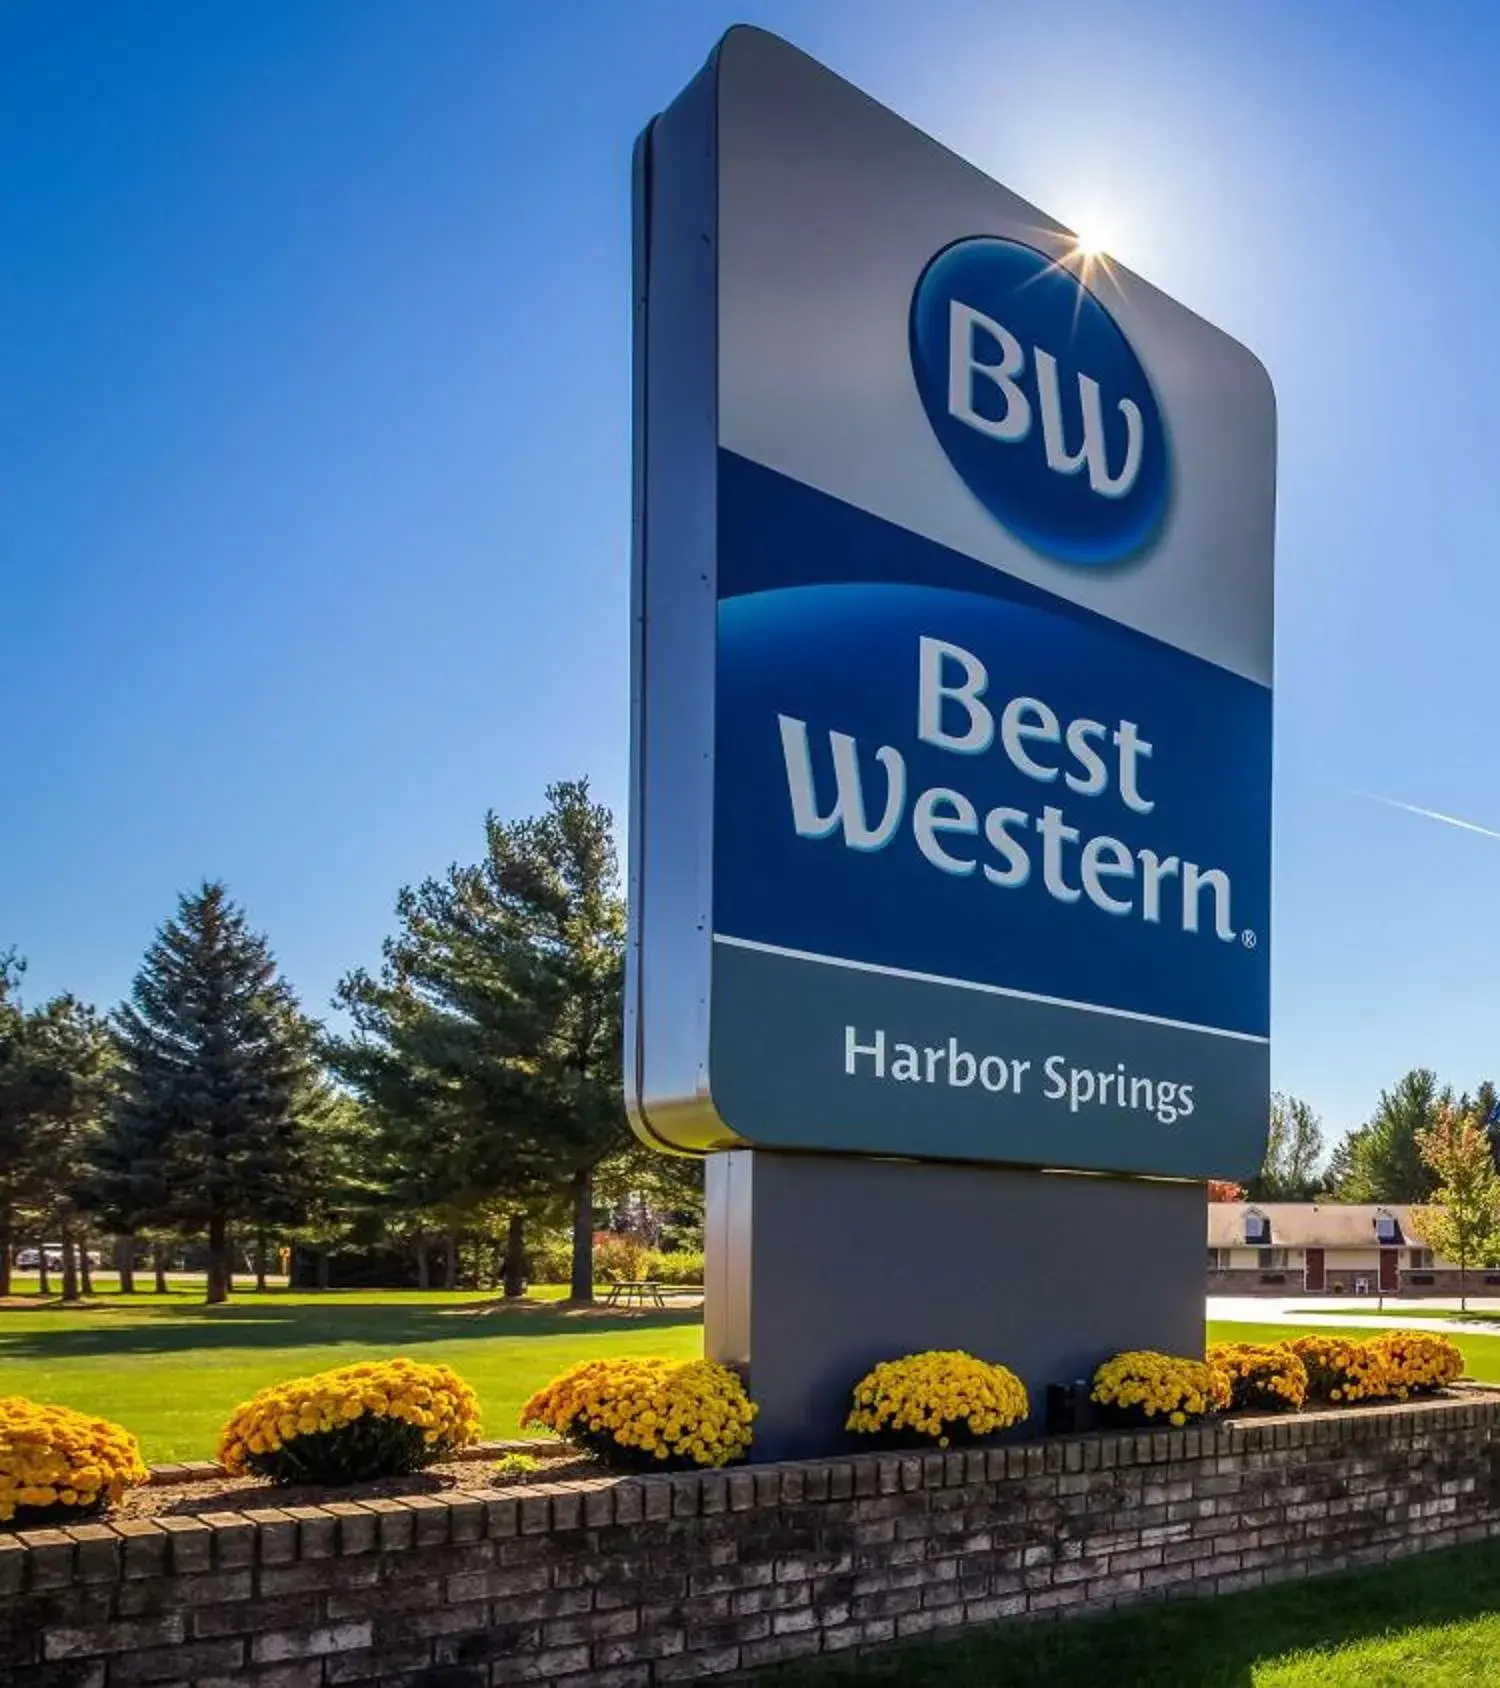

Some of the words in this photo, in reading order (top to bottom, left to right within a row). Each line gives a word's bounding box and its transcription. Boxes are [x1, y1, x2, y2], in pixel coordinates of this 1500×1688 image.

[948, 300, 1144, 498] BW
[918, 635, 1155, 813] Best
[844, 1025, 1031, 1100] Harbor
[1043, 1055, 1196, 1125] Springs
